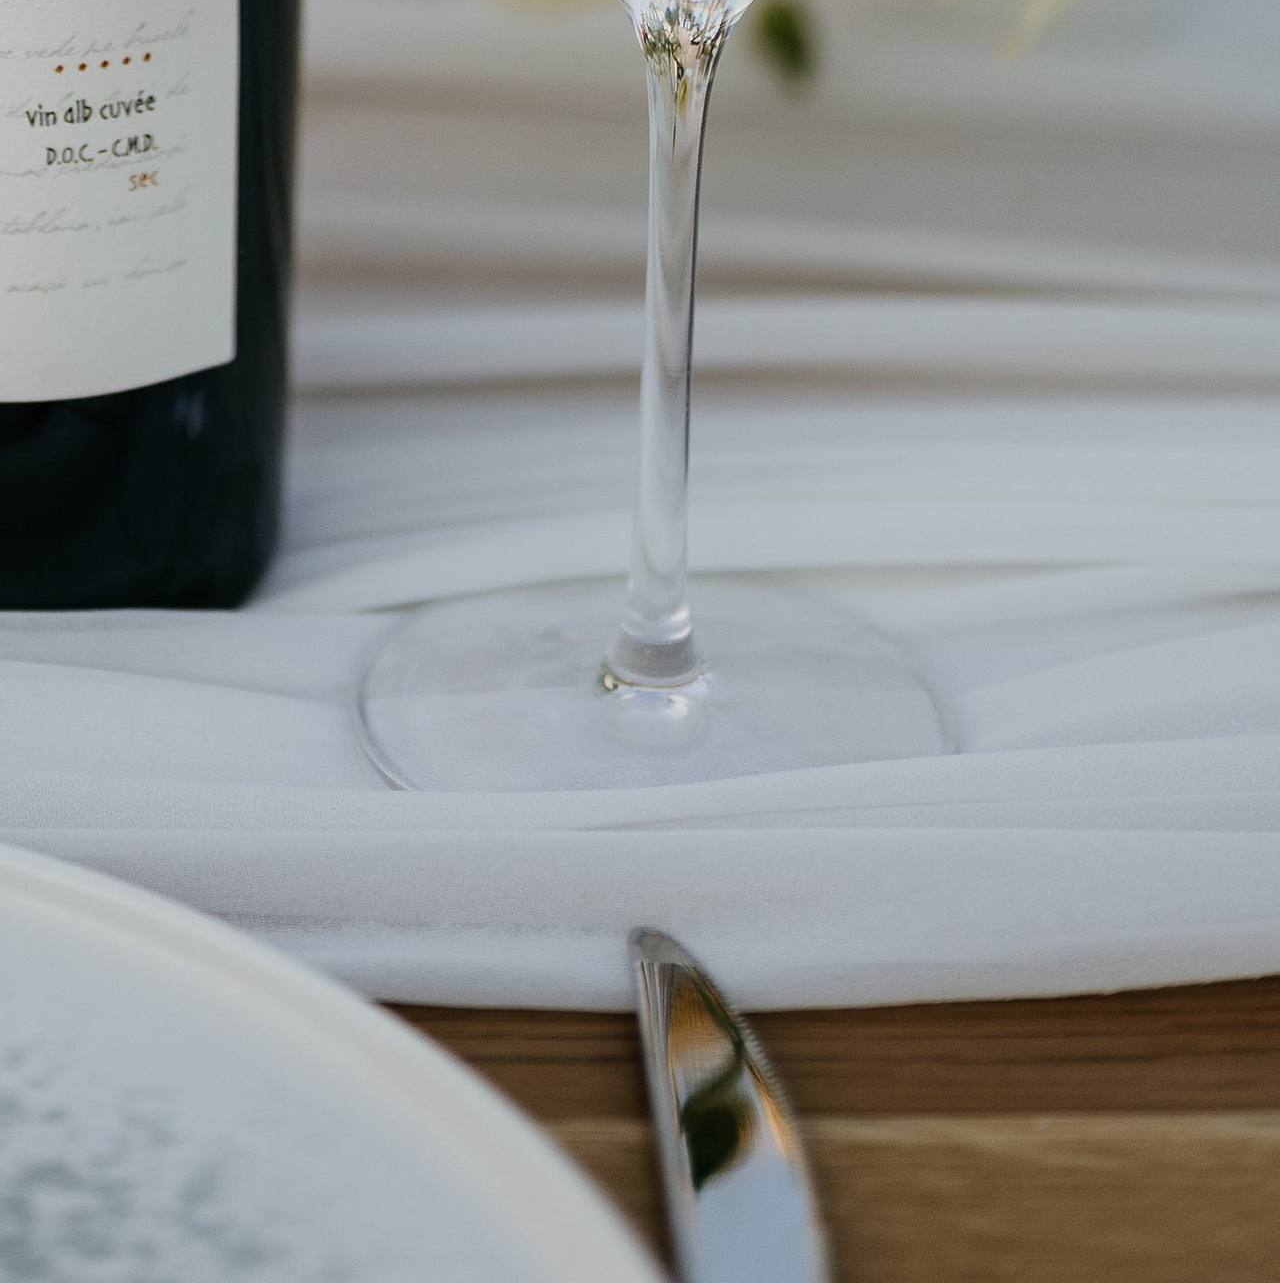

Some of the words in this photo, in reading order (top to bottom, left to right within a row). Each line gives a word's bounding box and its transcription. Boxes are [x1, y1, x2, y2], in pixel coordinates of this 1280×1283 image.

[24, 103, 57, 128] vin
[63, 98, 94, 125] alb
[99, 88, 157, 121] cuvée
[127, 169, 162, 192] sec
